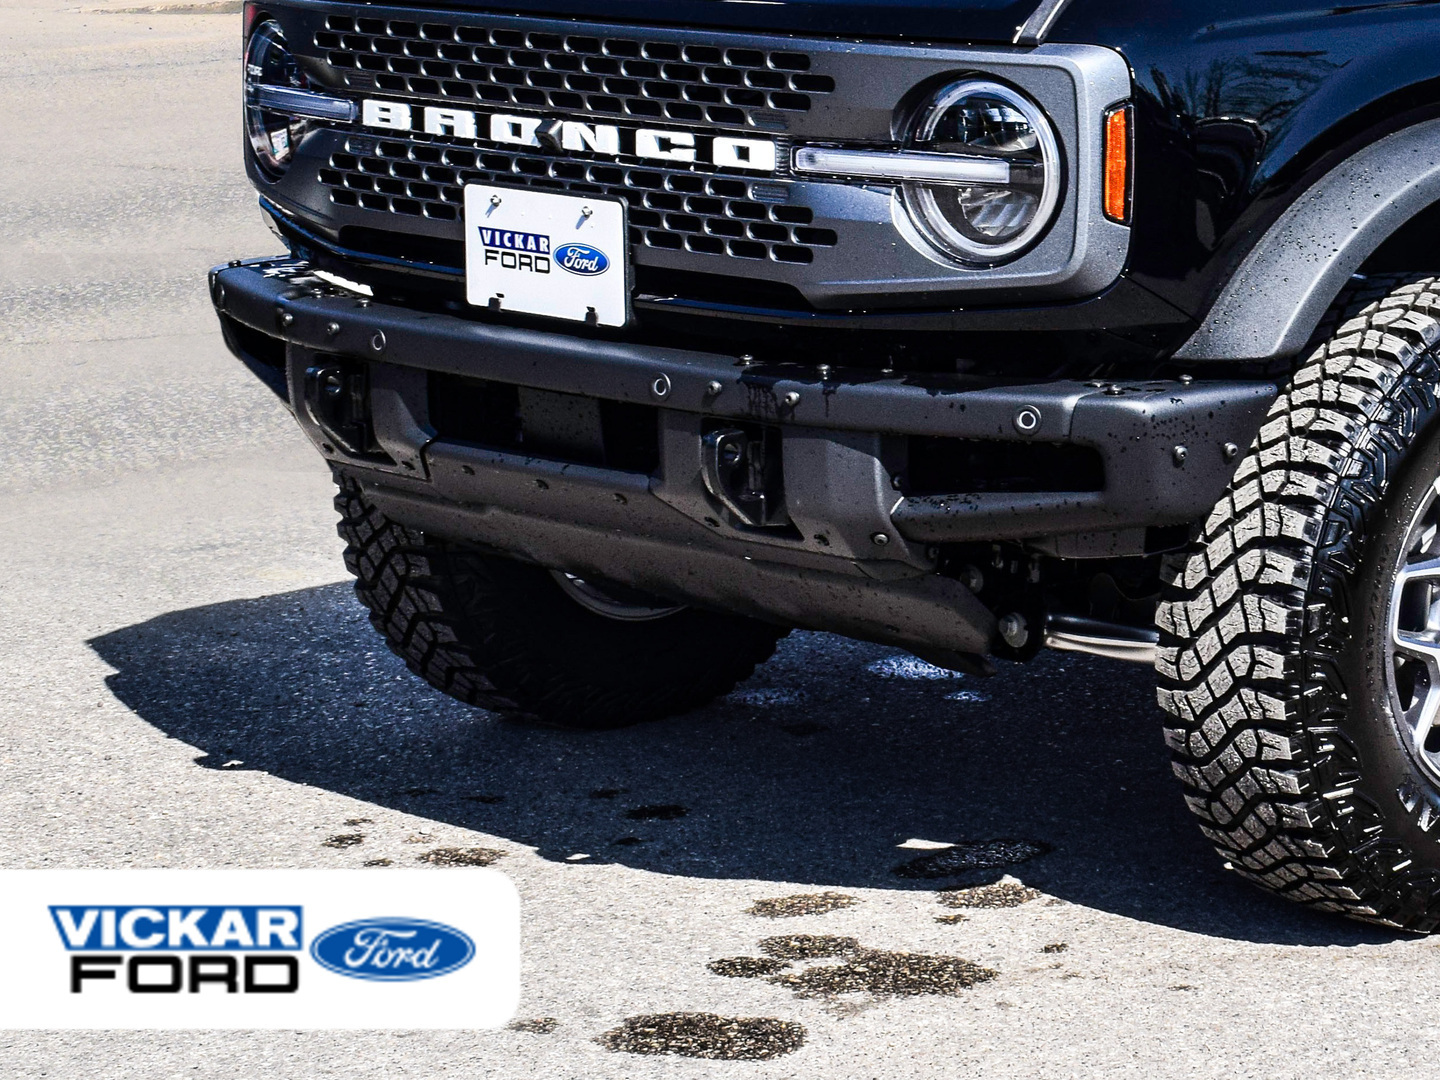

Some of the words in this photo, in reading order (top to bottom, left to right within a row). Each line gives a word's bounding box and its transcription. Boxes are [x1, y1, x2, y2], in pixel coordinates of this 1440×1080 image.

[362, 98, 777, 172] BRONCO
[481, 228, 549, 253] VICKAR
[484, 250, 551, 275] FORD
